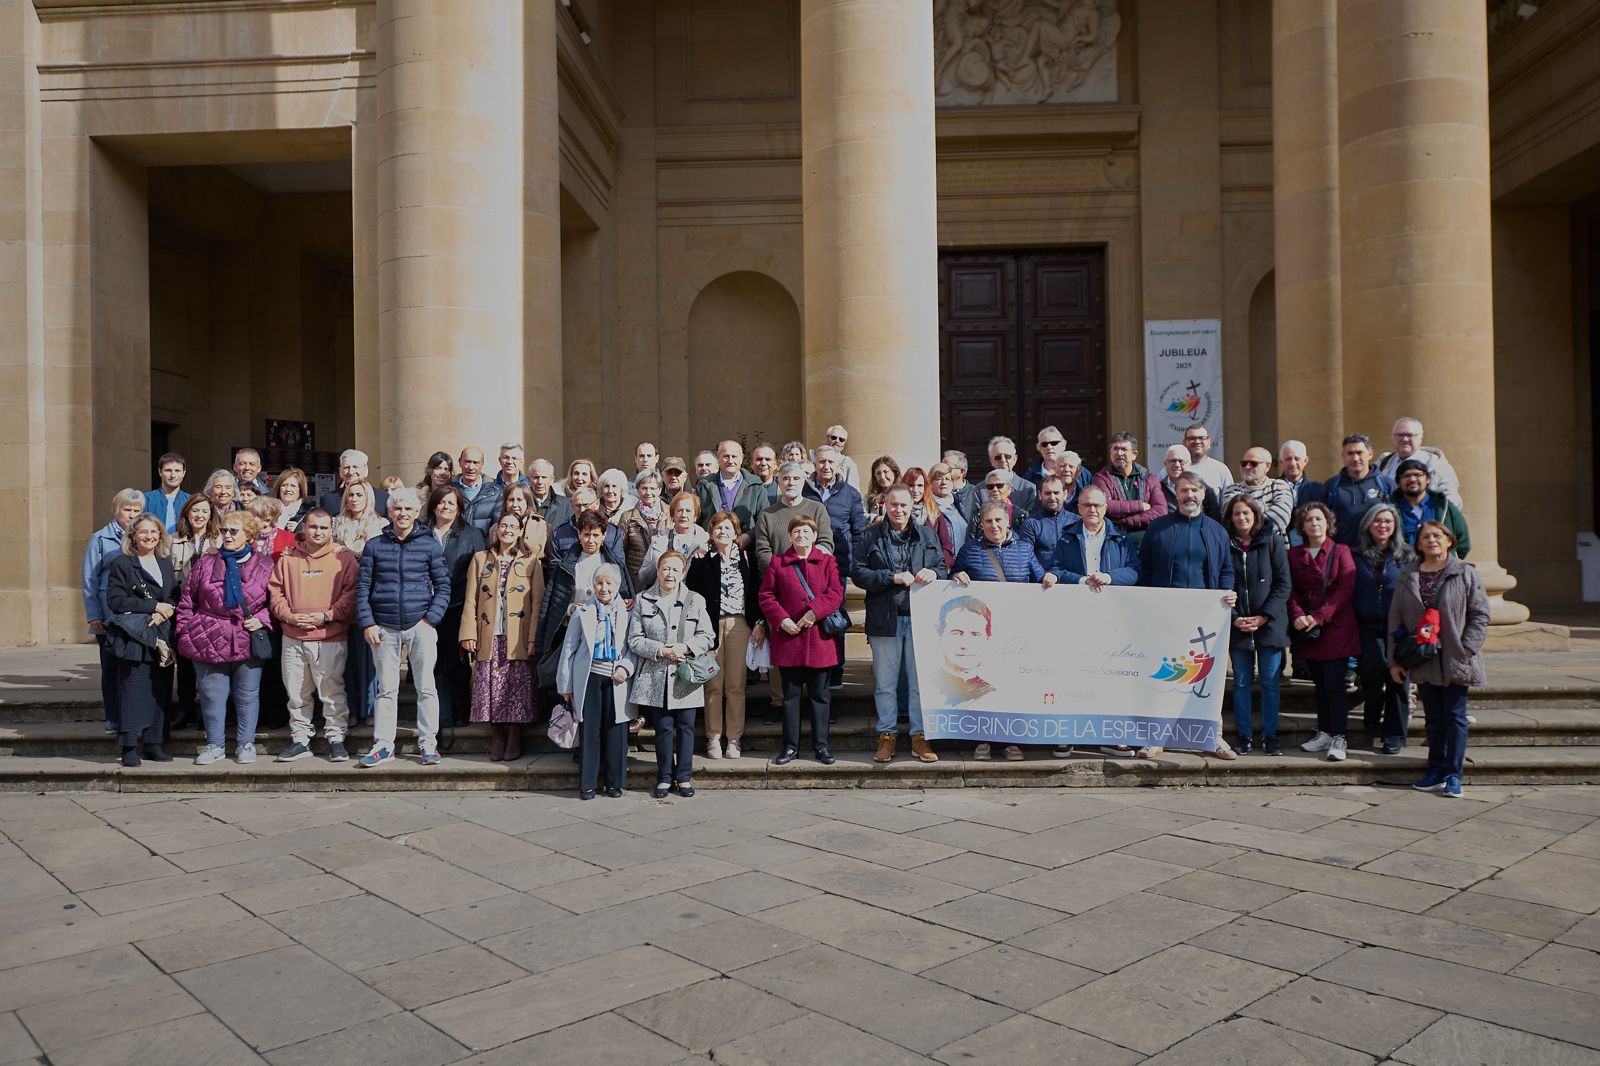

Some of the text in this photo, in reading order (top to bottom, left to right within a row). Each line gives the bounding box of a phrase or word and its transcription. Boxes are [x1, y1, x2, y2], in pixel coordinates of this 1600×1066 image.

[1159, 348, 1207, 357] JUBILEUA
[927, 713, 1216, 744] EREGRINOS DE LA ESPERANZA
